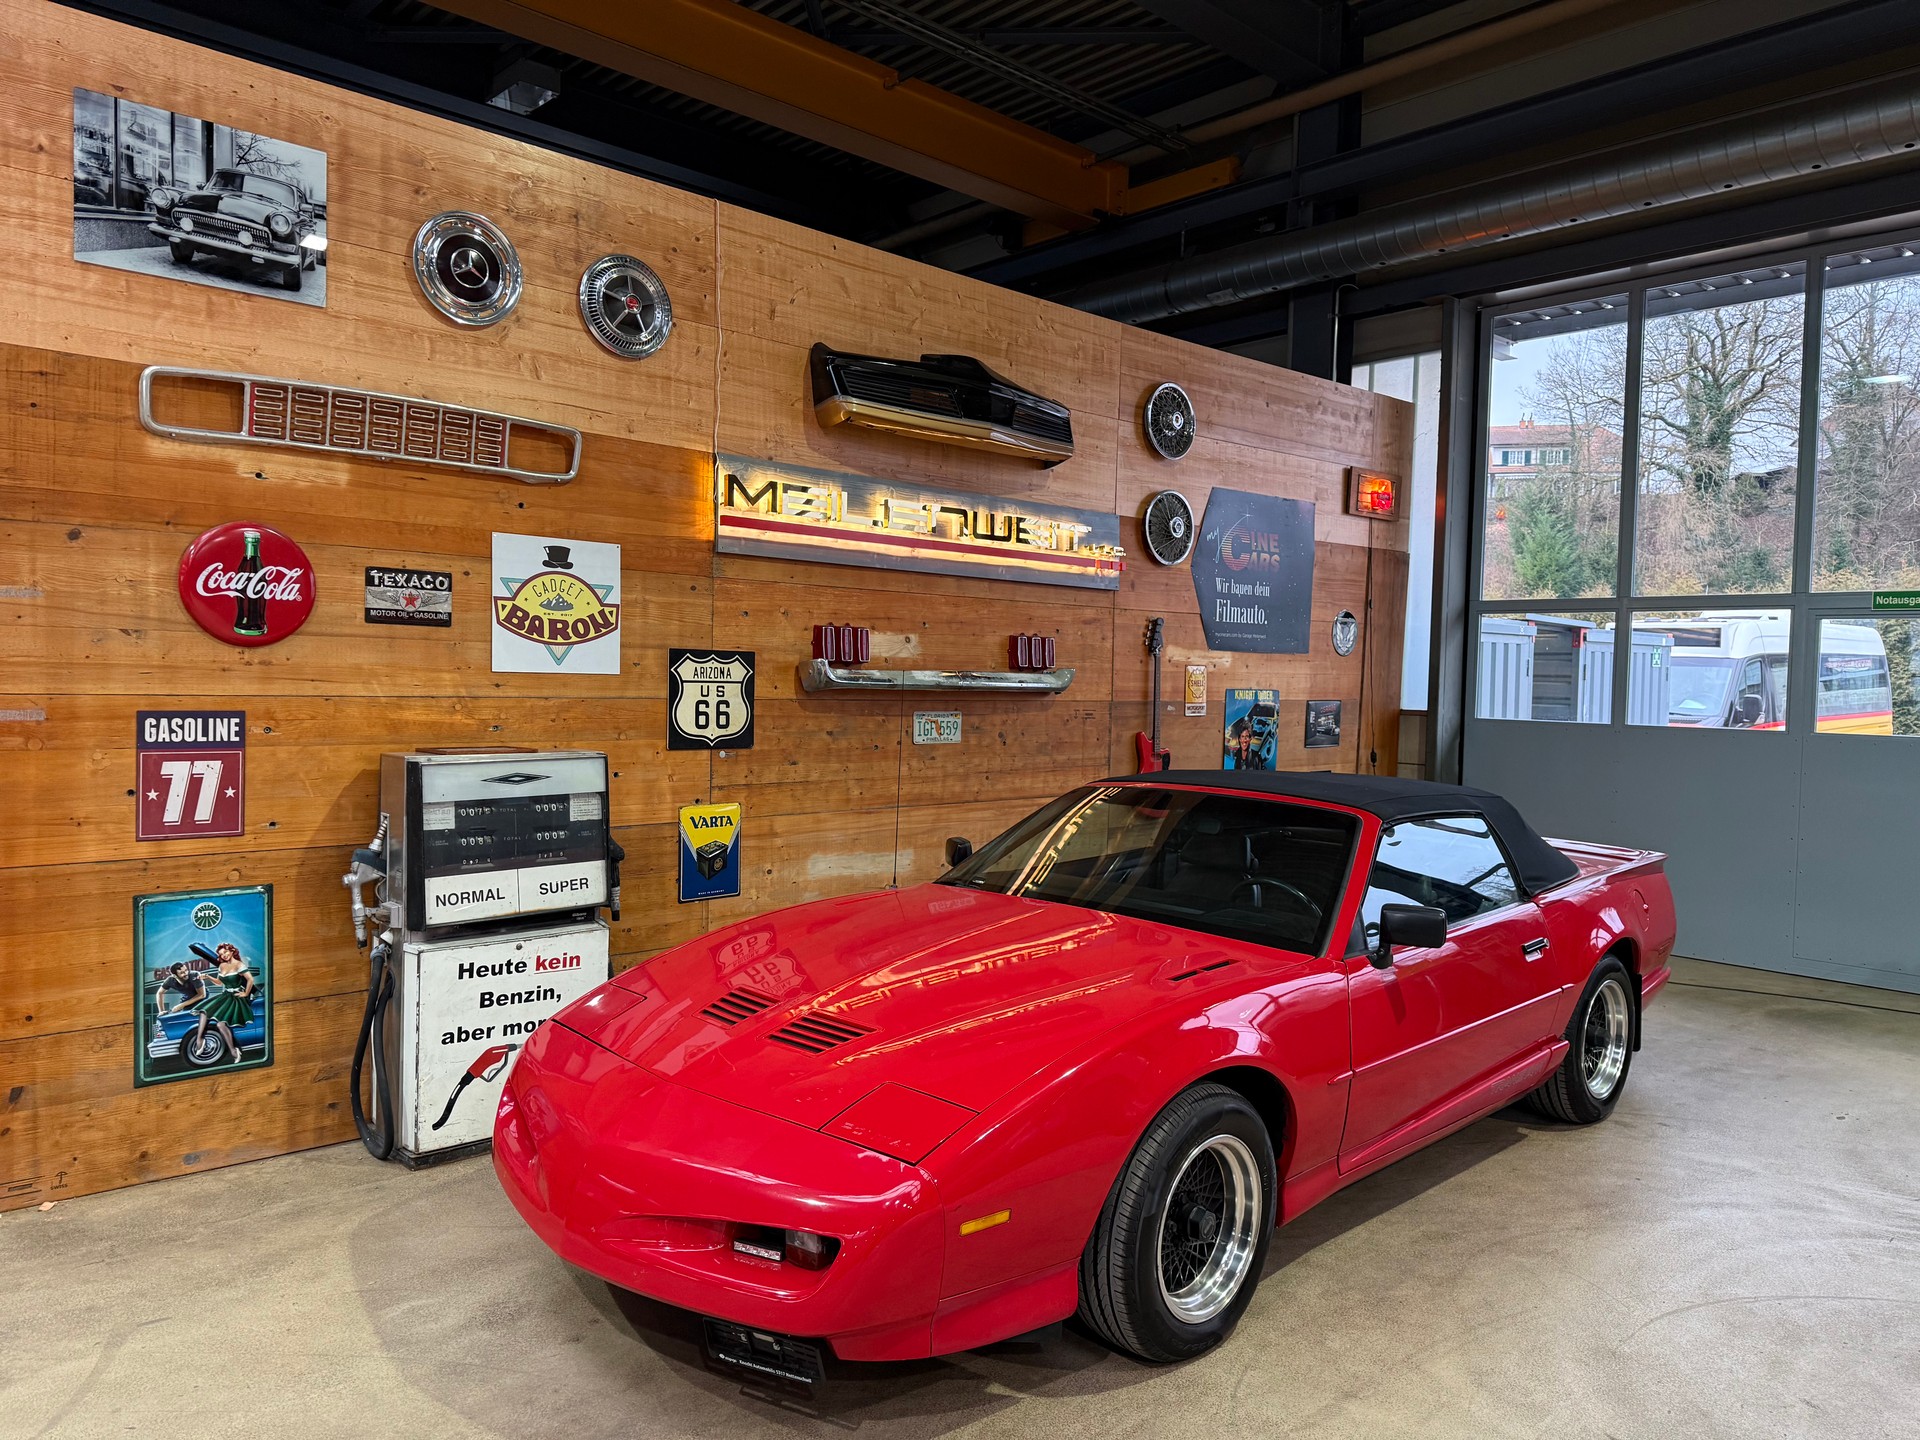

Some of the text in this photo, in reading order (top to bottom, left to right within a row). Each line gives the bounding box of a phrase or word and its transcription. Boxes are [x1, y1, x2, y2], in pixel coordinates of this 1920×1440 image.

[195, 562, 304, 602] Coca-Cola
[369, 569, 449, 590] TEXACO
[531, 578, 584, 600] GADGET
[1215, 577, 1270, 597] Wir bauen dein
[370, 609, 396, 617] MOTOR
[413, 612, 449, 620] GASOLINE
[501, 603, 614, 641] BARON
[1215, 598, 1268, 625] Filmauto.
[693, 667, 732, 679] ARIZONA
[1234, 689, 1256, 700] KNIGHT
[695, 700, 730, 730] 66
[144, 717, 241, 743] GASOLINE
[160, 760, 224, 826] 77
[689, 815, 734, 829] VARTA
[435, 877, 590, 908] NORMAL SUPER
[197, 909, 216, 918] NTK
[458, 952, 582, 980] Heute kein
[479, 985, 562, 1009] Benzin,
[441, 1025, 496, 1046] aber
